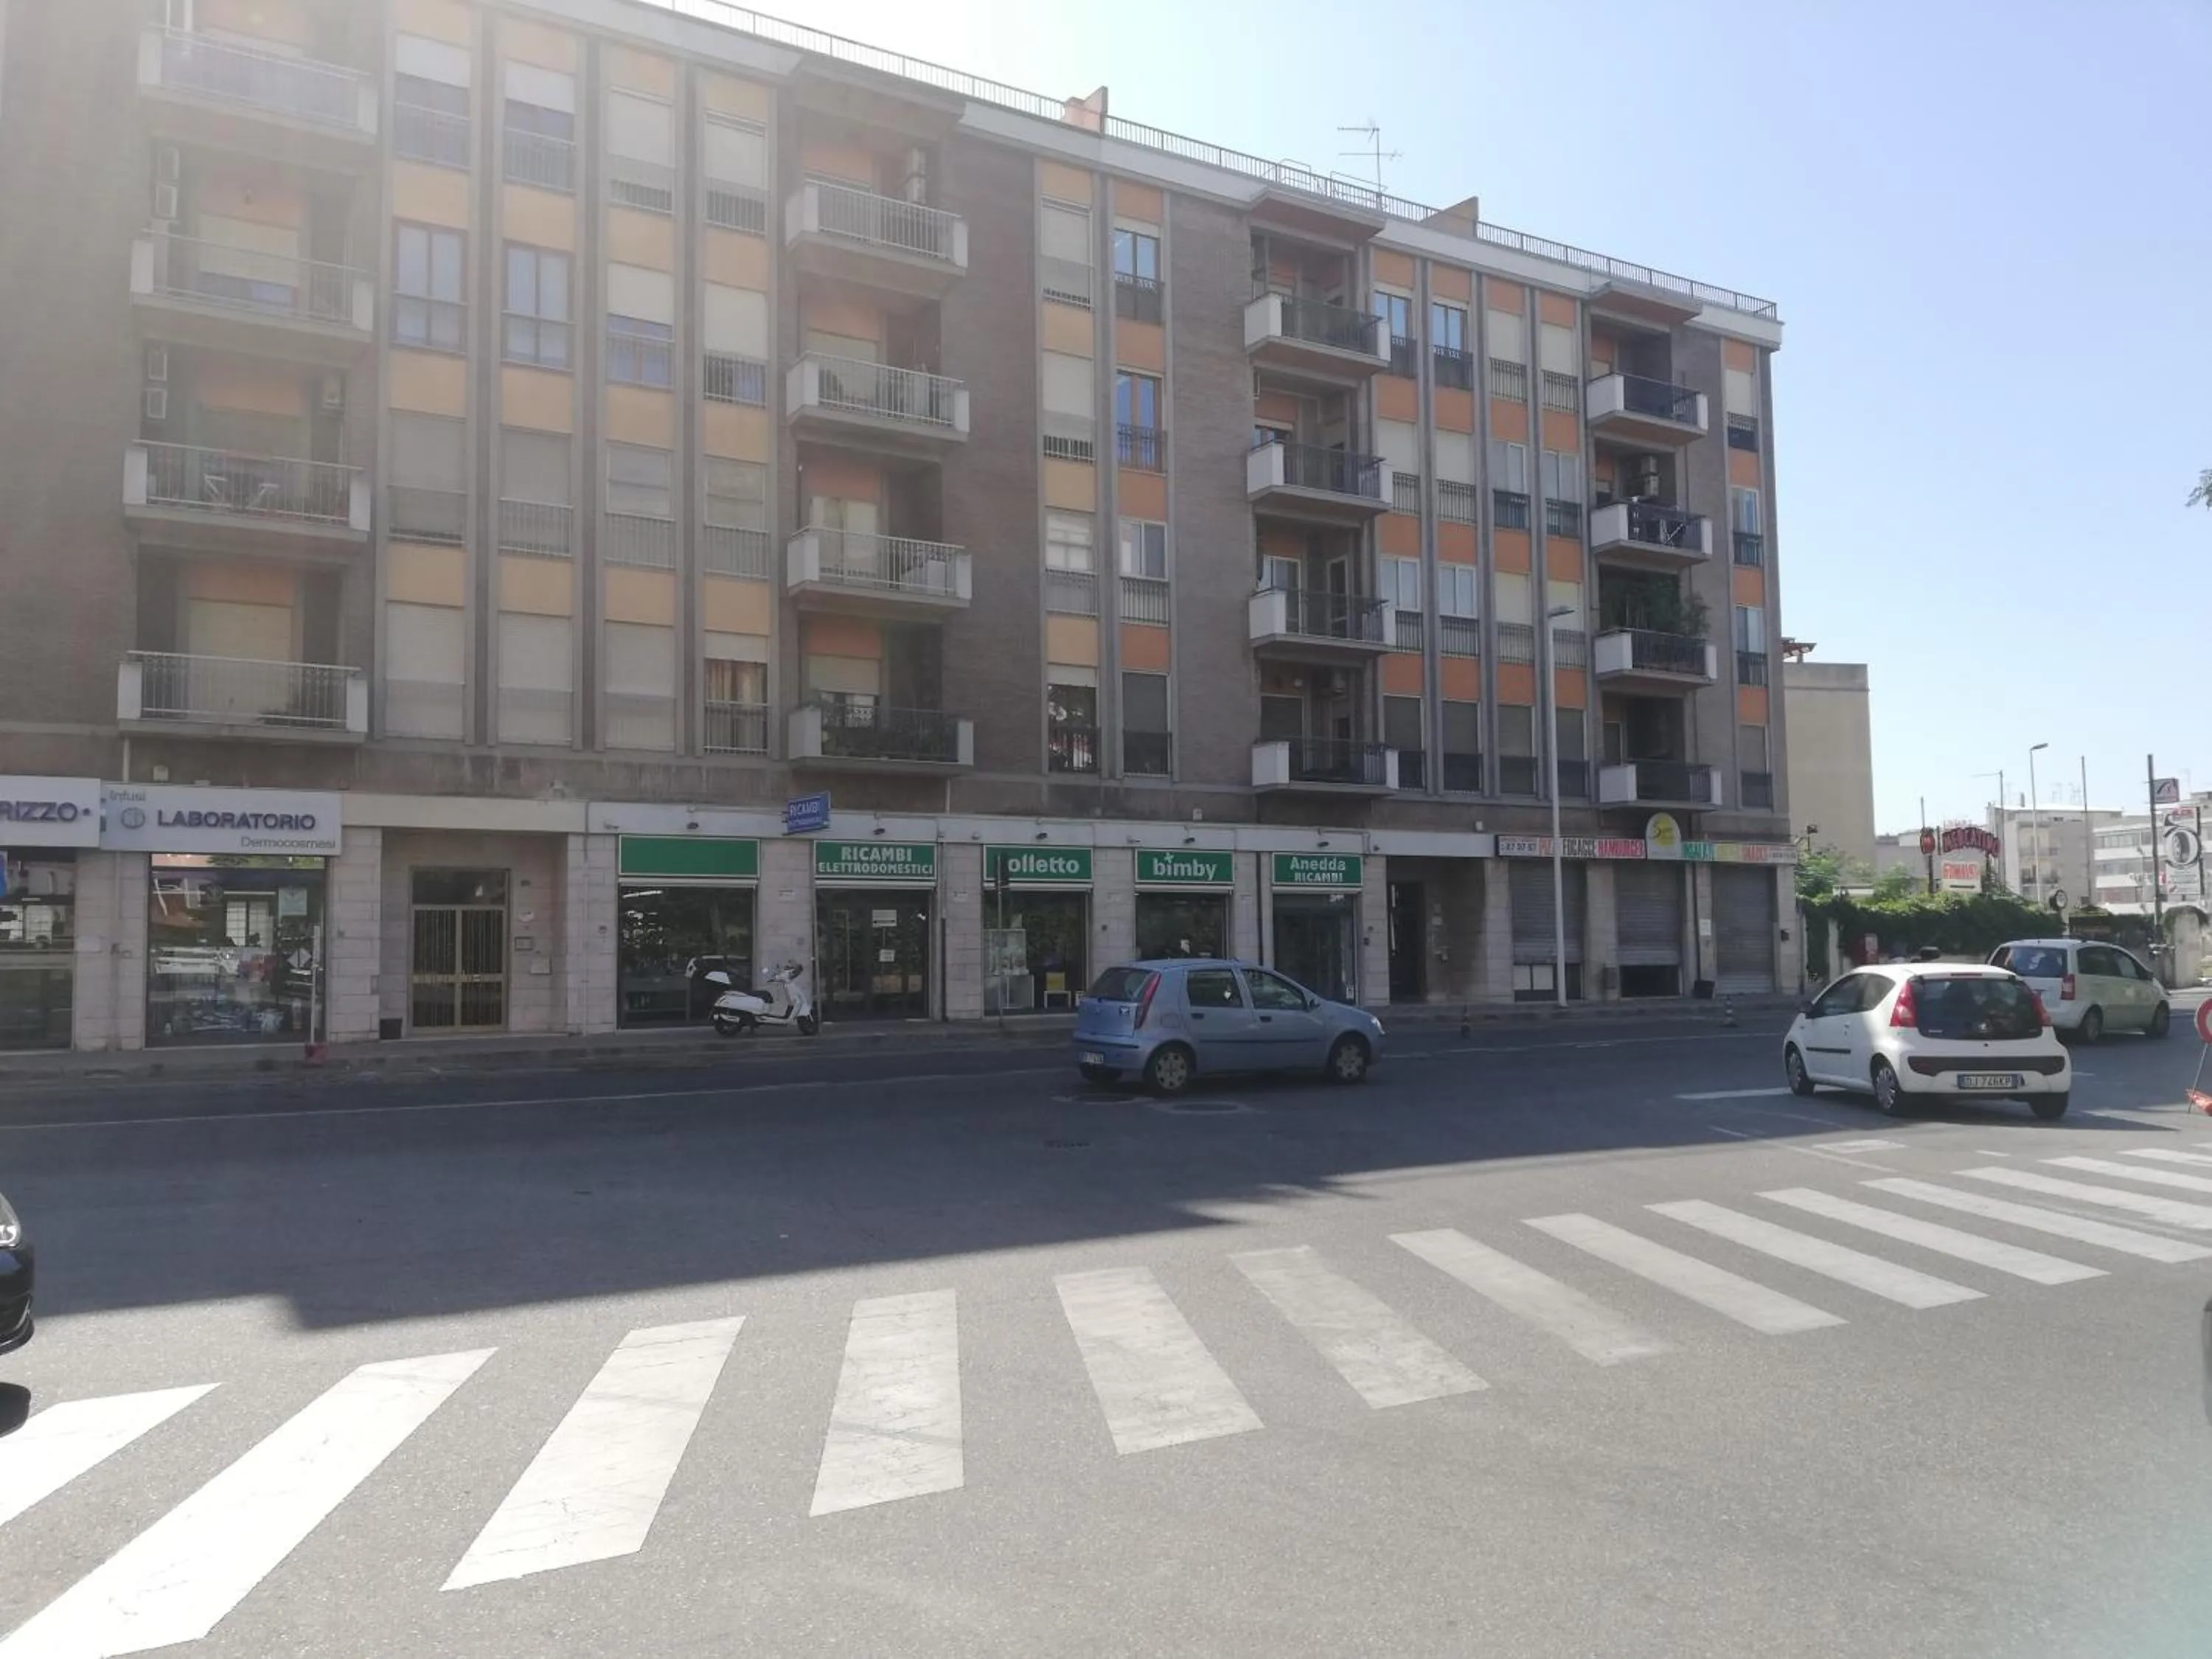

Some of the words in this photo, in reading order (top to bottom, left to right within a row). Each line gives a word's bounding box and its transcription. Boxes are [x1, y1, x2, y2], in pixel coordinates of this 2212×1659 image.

[157, 809, 316, 830] LABORATORIO
[240, 836, 336, 849] Dermocosmesi
[841, 846, 912, 862] RICAMBI
[818, 862, 933, 874] ELETTRODOMESTICI
[1007, 854, 1079, 874] olletto
[1152, 852, 1217, 880] bimby
[1290, 856, 1346, 871] Anedda
[1294, 872, 1343, 883] RICAMBI
